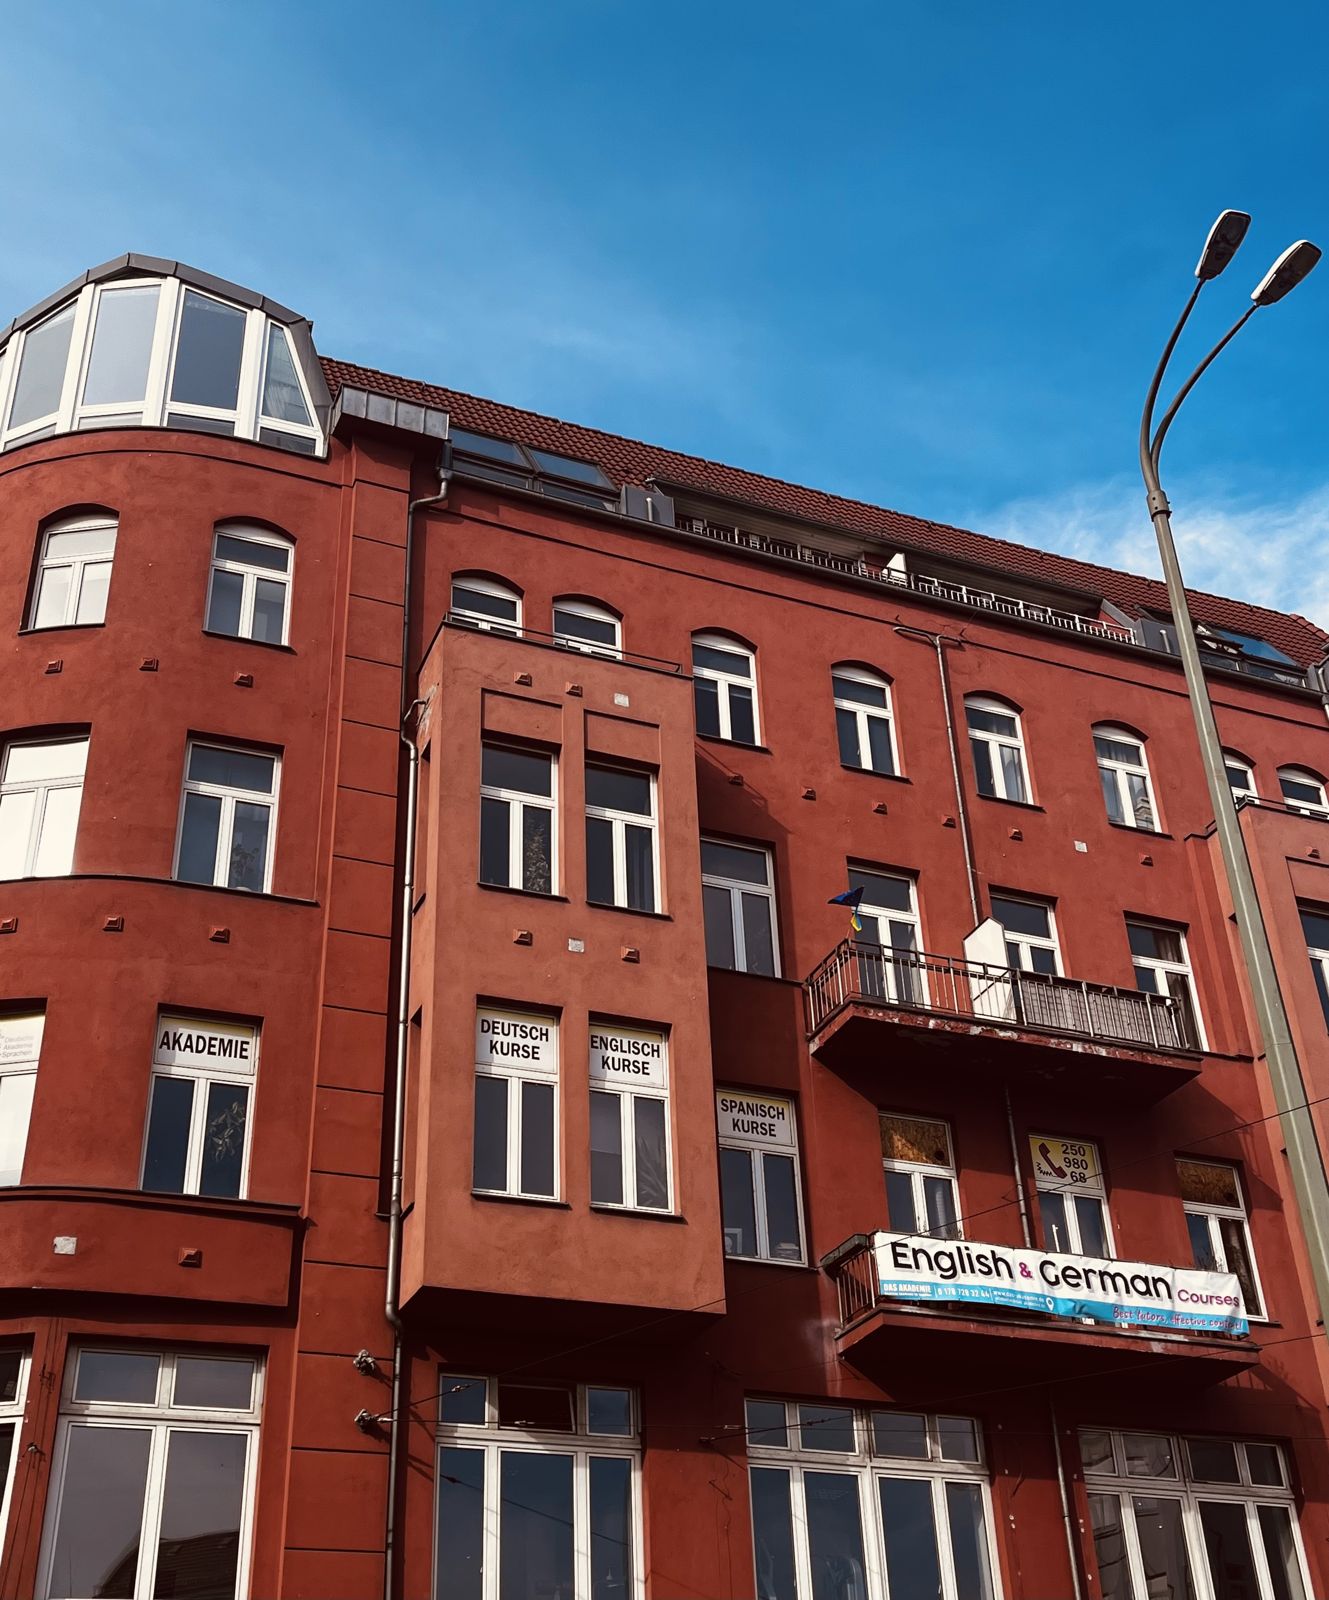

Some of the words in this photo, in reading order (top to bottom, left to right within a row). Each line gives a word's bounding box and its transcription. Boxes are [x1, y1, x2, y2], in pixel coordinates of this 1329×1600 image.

[480, 1018, 549, 1042] DEUTSCH
[159, 1030, 250, 1060] AKADEMIE
[489, 1039, 541, 1061] KURSE
[590, 1034, 661, 1059] ENGLISCH
[601, 1055, 651, 1076] KURSE
[720, 1098, 785, 1121] SPANISCH
[732, 1117, 777, 1138] KURSE
[1060, 1143, 1086, 1157] 250
[1063, 1156, 1089, 1171] 980
[1070, 1170, 1087, 1184] 68
[890, 1241, 1014, 1280] English
[1019, 1261, 1033, 1279] &
[1039, 1259, 1173, 1300] German
[1177, 1288, 1240, 1307] Courses
[883, 1283, 898, 1292] DAS
[898, 1283, 931, 1293] AKADEMIE
[1112, 1306, 1134, 1320] Best
